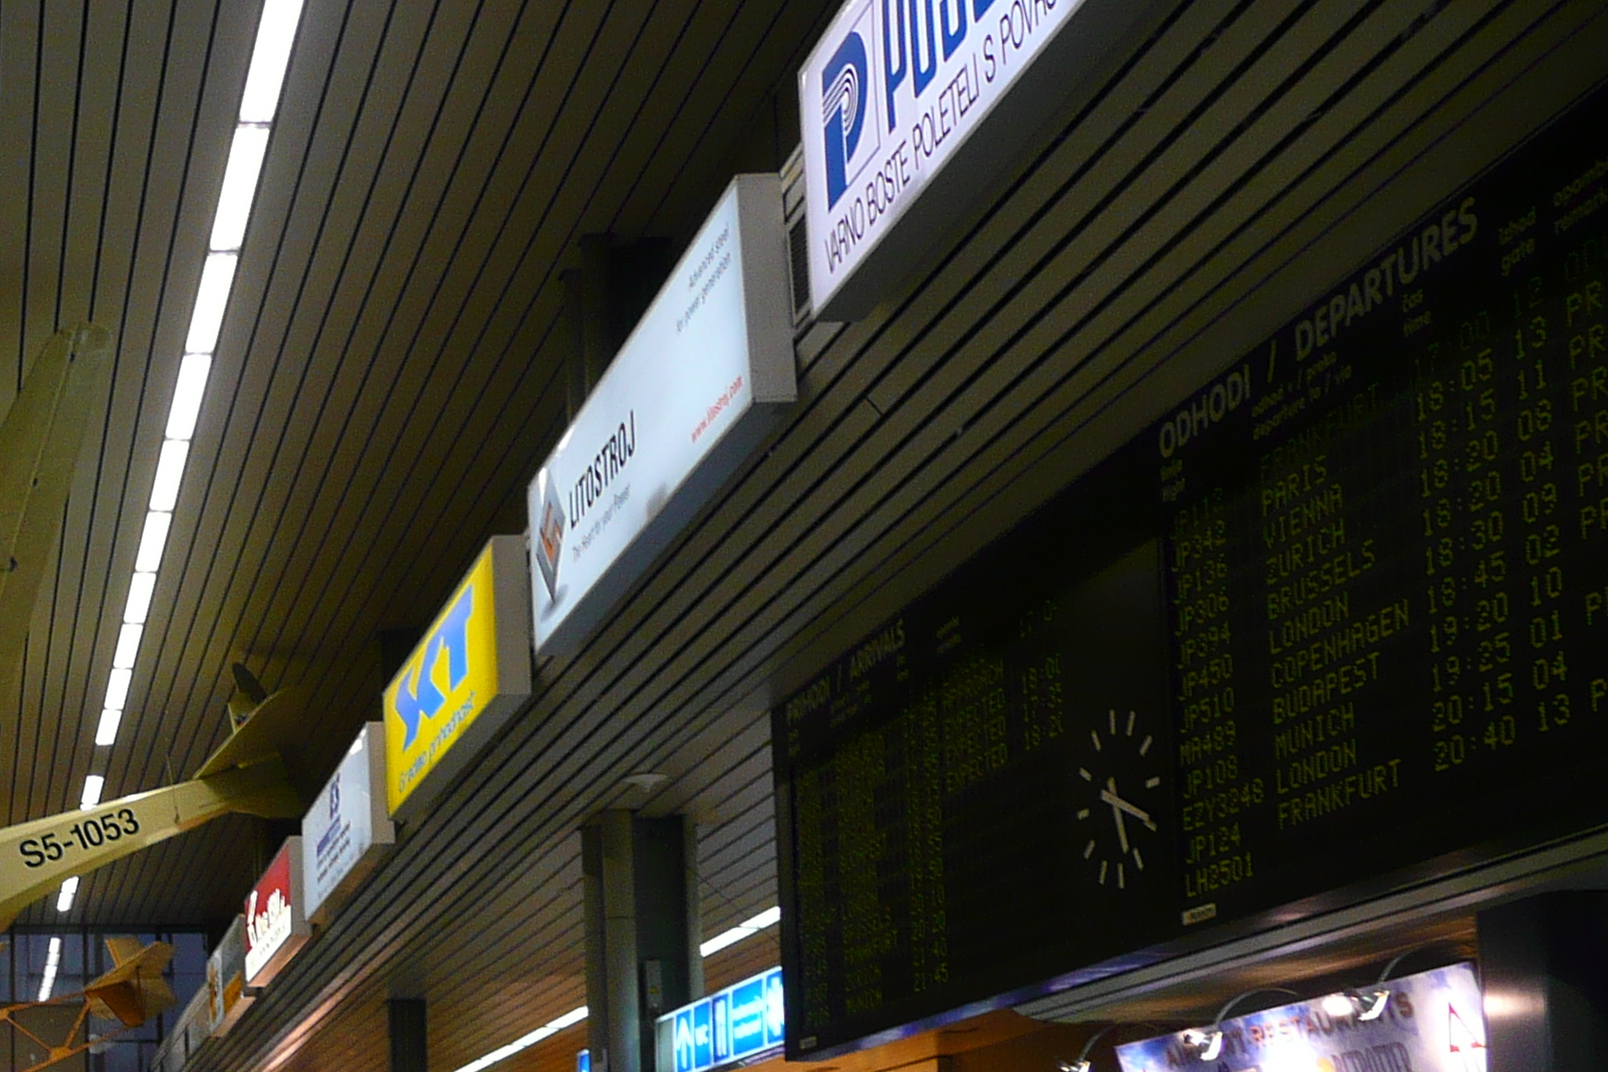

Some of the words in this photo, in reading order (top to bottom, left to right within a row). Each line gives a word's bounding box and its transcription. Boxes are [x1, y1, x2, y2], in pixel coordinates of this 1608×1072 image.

[825, 197, 866, 274] VARNO
[865, 140, 911, 227] BOSTE
[911, 53, 980, 172] POLETELI
[983, 33, 997, 84] S
[1158, 362, 1253, 459] ODHODI
[1294, 196, 1480, 364] DEPARTURES
[568, 408, 636, 530] LITOSTROJ
[1261, 453, 1328, 518] PARIS
[1418, 347, 1494, 422] 18:05
[1513, 315, 1548, 361] 13
[1263, 481, 1344, 548] VIENNA
[1418, 387, 1497, 460] 18:15
[1517, 357, 1548, 401] 11
[1265, 537, 1377, 620] BRUSSELS
[1519, 440, 1556, 484] 04
[1265, 517, 1347, 586] ZURICH
[1269, 588, 1352, 656] LONDON
[1423, 509, 1505, 578] 18:30
[1179, 686, 1235, 734] JP510
[1269, 597, 1410, 690] COPENHAGEN
[1426, 550, 1508, 616] 18:45
[1272, 651, 1382, 726] BUDAPEST
[1530, 564, 1565, 608] 10
[1273, 701, 1356, 762] MUNICH
[1528, 608, 1564, 650] 01
[1275, 738, 1359, 796] LONDON
[1430, 671, 1514, 733] 20:15
[1531, 650, 1569, 692] 04
[1276, 757, 1403, 831] FRANKFURT
[1432, 712, 1517, 774] 20:40
[1538, 692, 1572, 733] 13
[19, 806, 141, 870] S5-1053
